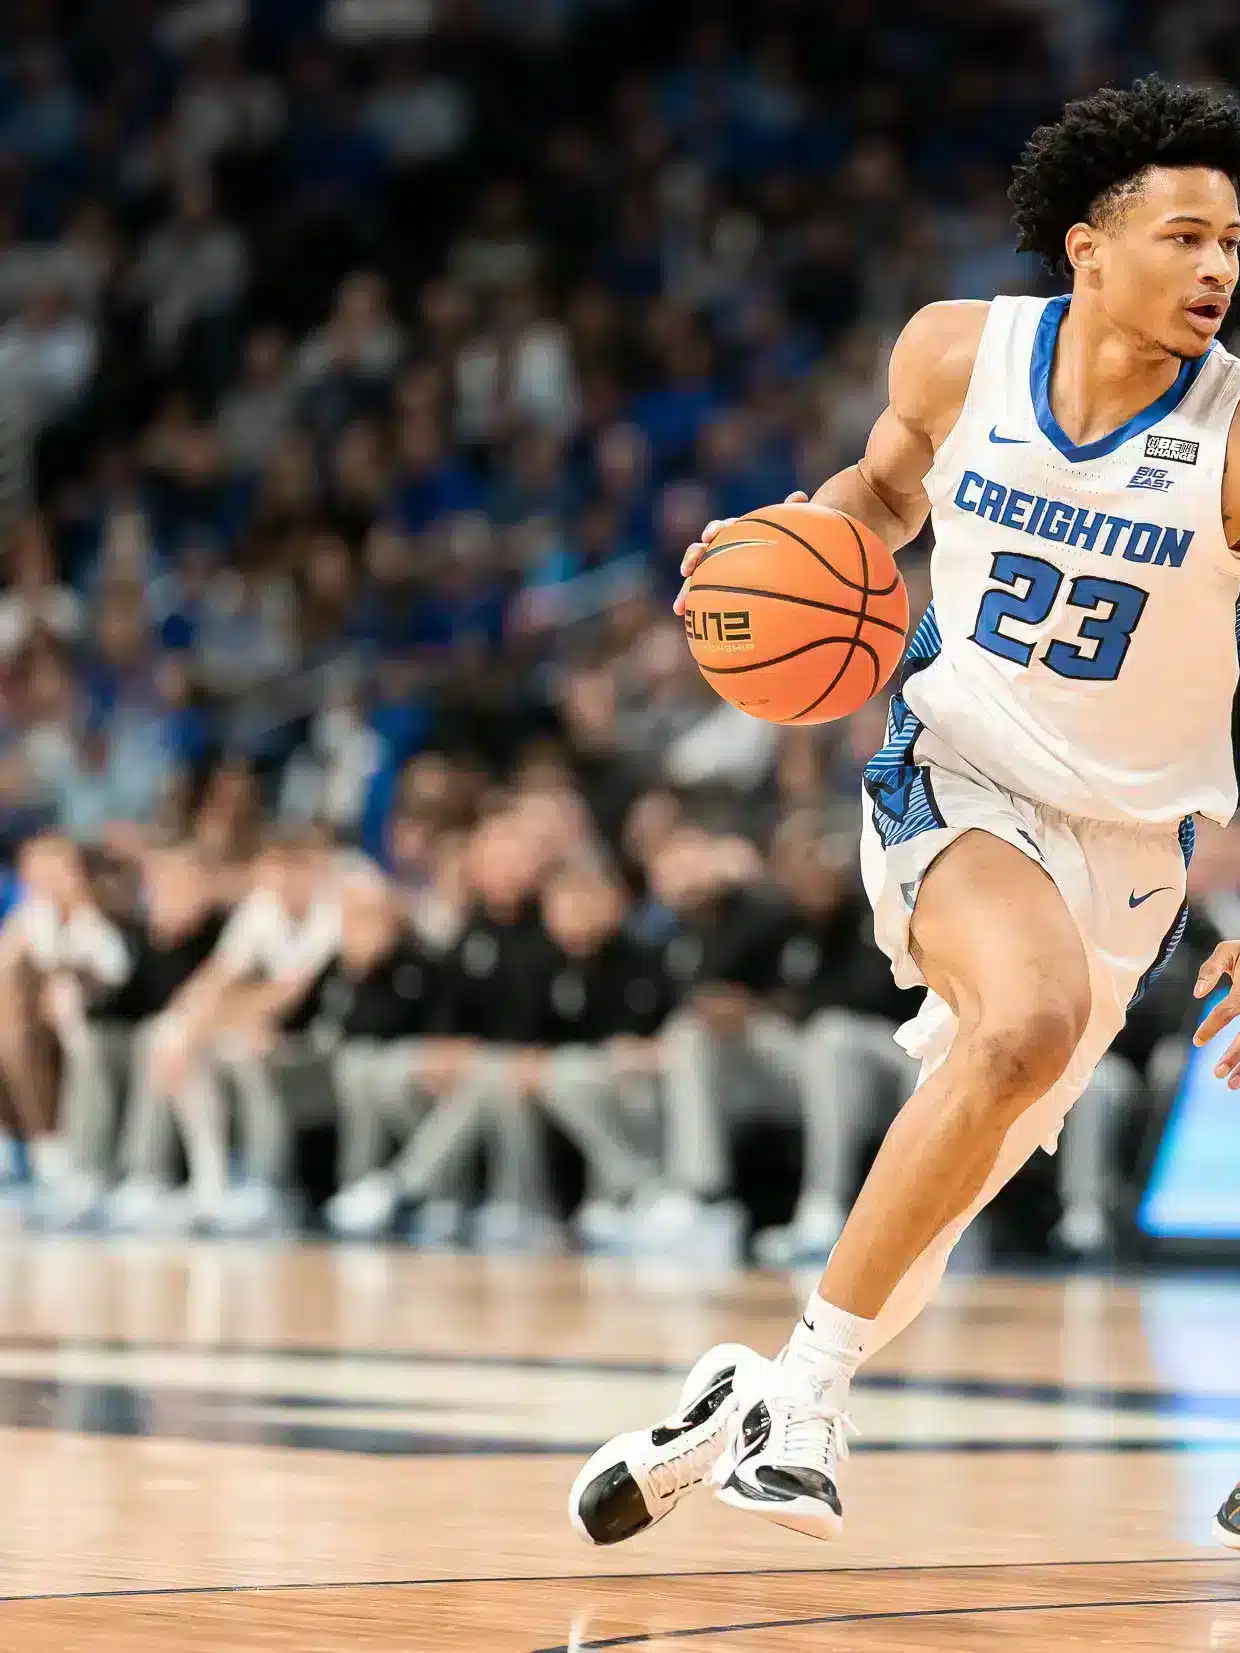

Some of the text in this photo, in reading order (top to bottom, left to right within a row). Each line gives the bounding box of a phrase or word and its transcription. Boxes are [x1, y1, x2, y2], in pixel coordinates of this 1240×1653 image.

[1158, 438, 1181, 452] BE
[1146, 447, 1196, 463] CHANGE
[1136, 466, 1169, 479] BIG
[1130, 475, 1175, 489] EAST
[953, 470, 1196, 568] CREIGHTON
[967, 551, 1150, 682] 23
